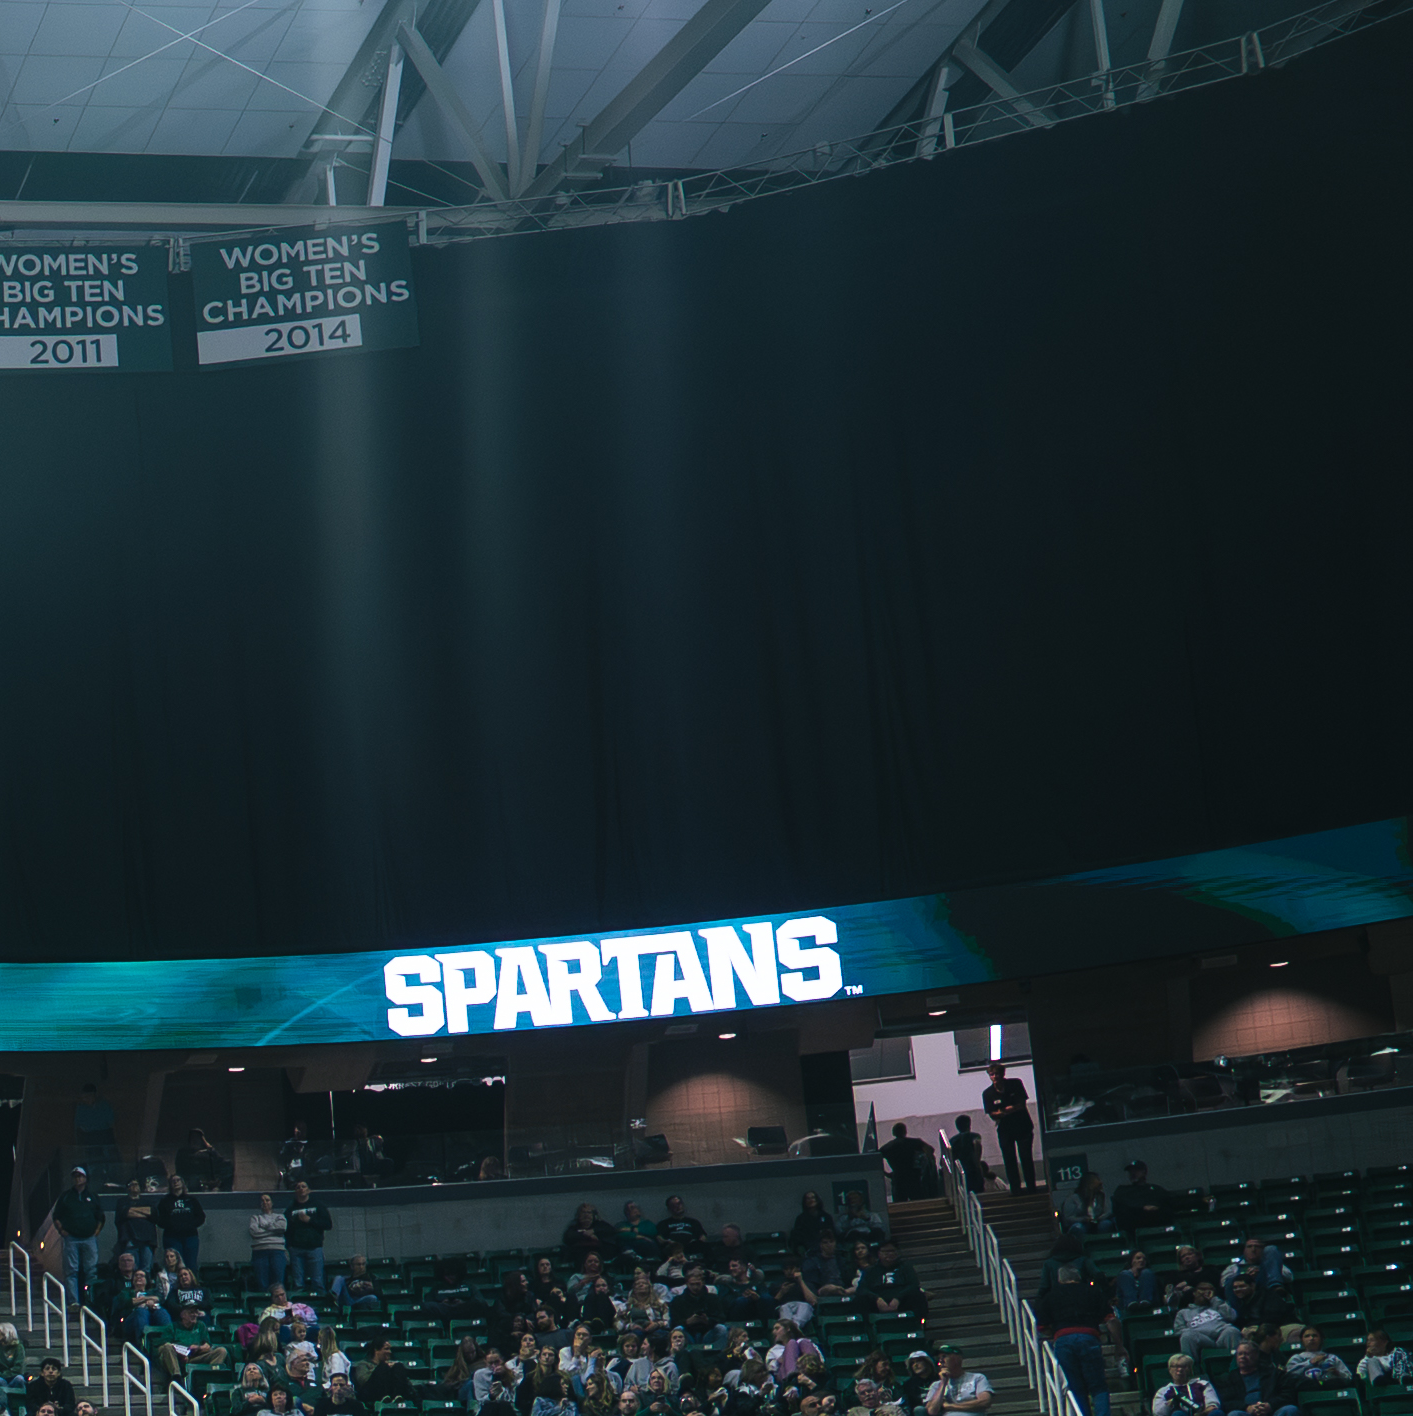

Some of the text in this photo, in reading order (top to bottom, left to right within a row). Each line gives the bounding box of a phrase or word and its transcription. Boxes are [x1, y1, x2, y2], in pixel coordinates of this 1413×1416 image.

[219, 232, 381, 270] WOMEN'S
[3, 279, 125, 303] BIG TEN
[239, 259, 368, 296] BIG TEN
[202, 279, 410, 325] CHAMPIONS
[29, 338, 104, 365] 2011
[264, 318, 352, 355] 2014
[383, 915, 843, 1037] SPARTANS
[1057, 1166, 1083, 1181] 113
